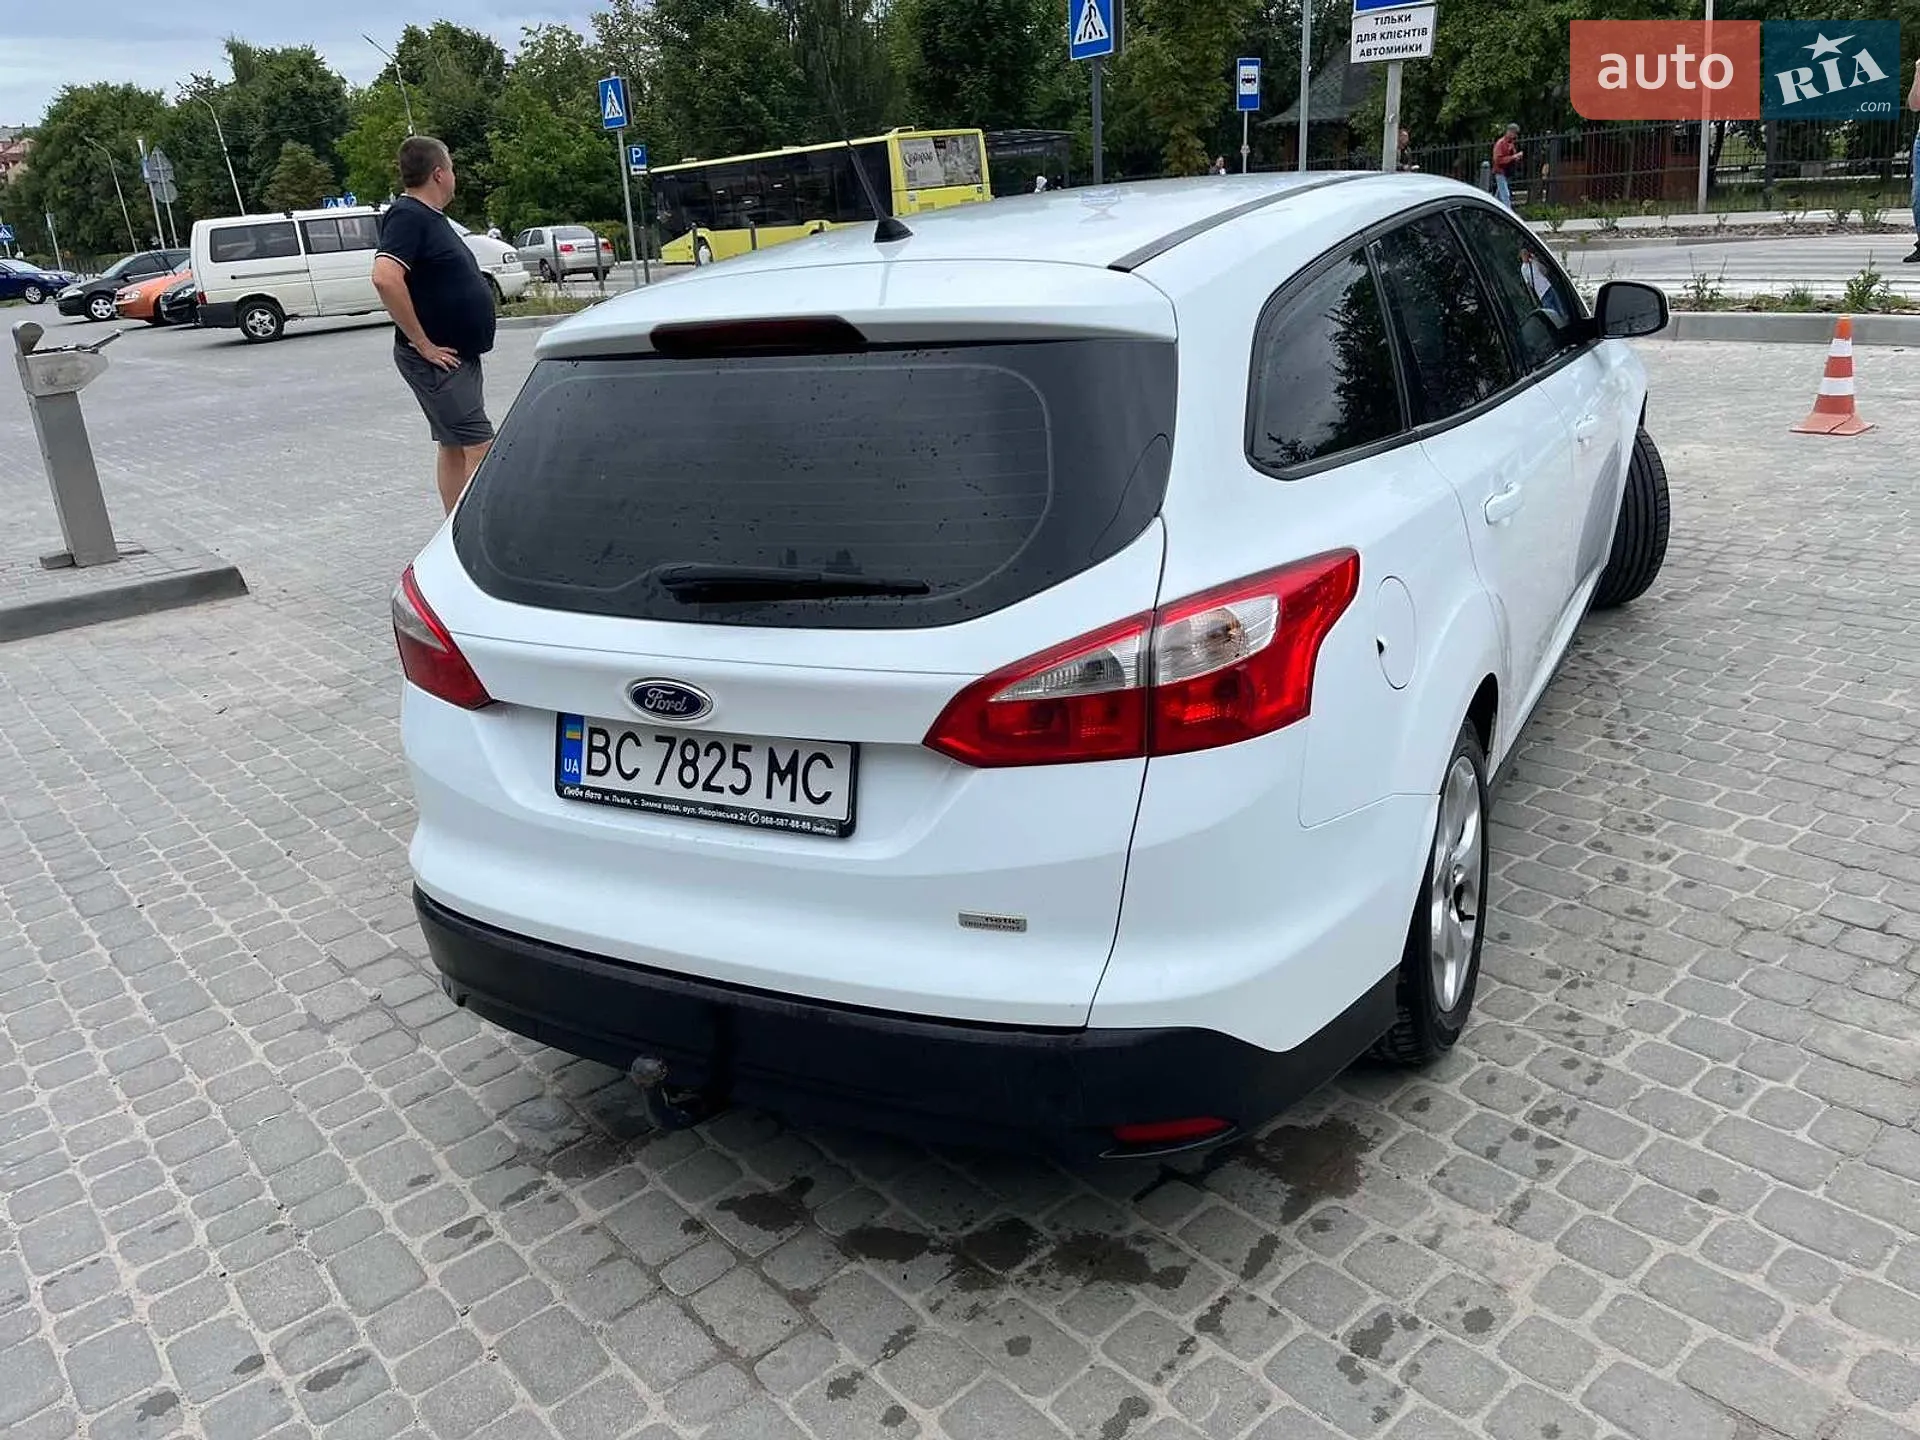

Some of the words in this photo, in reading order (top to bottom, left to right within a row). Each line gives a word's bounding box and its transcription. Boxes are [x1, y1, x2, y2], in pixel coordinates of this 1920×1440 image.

[1375, 14, 1411, 25] ТІЛЬКИ
[1356, 33, 1376, 43] ДЛЯ
[1380, 28, 1427, 39] КЛІЄНТІВ
[632, 148, 641, 163] P
[643, 687, 688, 713] Ford
[563, 757, 580, 775] UA
[586, 727, 642, 782] BC
[654, 735, 753, 796] 7825
[765, 746, 834, 806] MC
